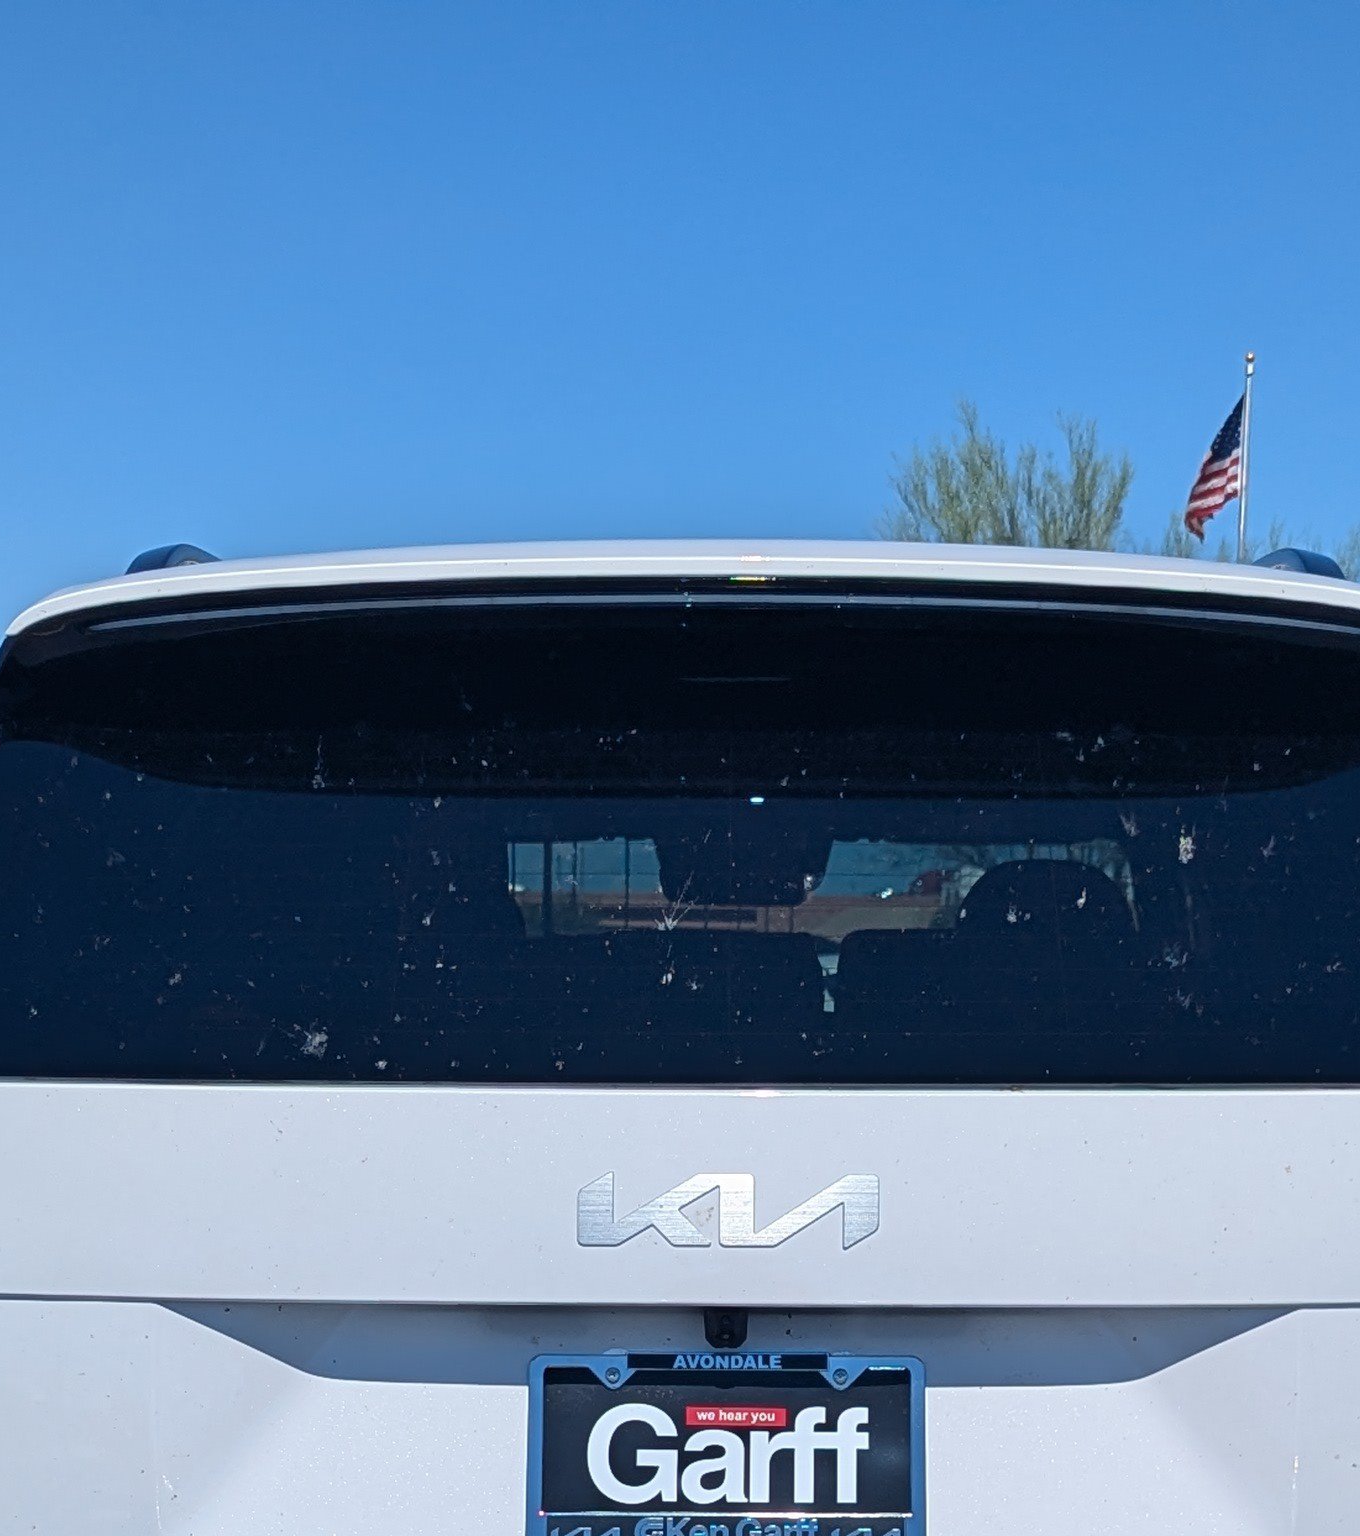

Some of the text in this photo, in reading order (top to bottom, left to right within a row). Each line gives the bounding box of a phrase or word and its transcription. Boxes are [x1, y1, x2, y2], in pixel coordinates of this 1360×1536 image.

[577, 1170, 880, 1251] KIA
[673, 1354, 783, 1370] AVONDALE
[697, 1408, 776, 1424] we hear you
[586, 1402, 870, 1505] Garff
